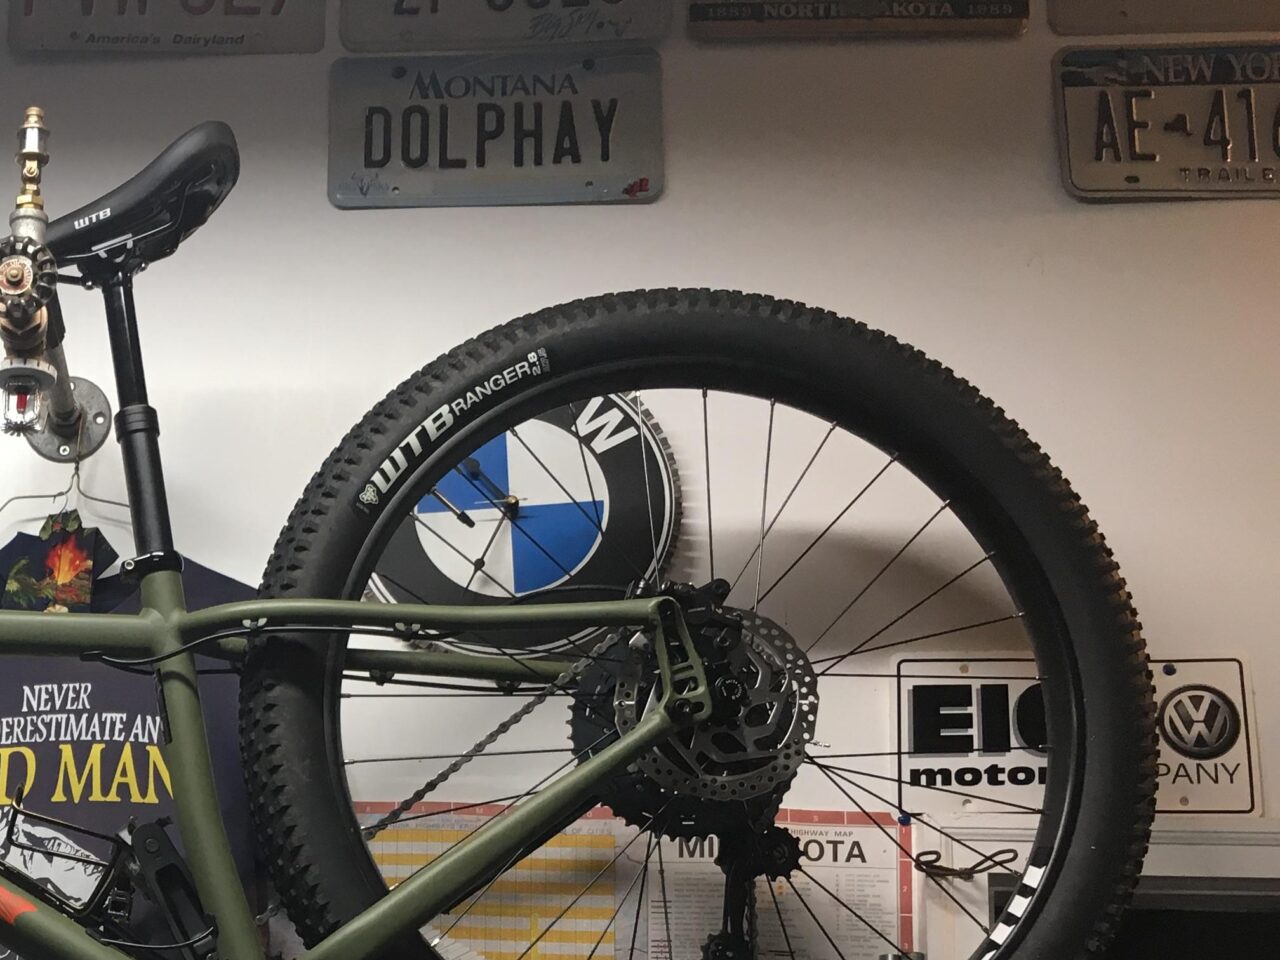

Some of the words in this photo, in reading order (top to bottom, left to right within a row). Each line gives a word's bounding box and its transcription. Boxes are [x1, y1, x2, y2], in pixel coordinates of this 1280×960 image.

[85, 32, 161, 46] America's
[172, 31, 246, 48] Dairyland
[1142, 53, 1217, 84] NEW
[408, 69, 580, 100] MONTANA
[362, 98, 620, 171] DOLPHAY
[1202, 87, 1280, 163] 41
[1178, 167, 1280, 183] TRAILE
[73, 207, 112, 231] WTB
[452, 361, 531, 417] RANGER
[527, 351, 541, 377] 2.8
[20, 682, 92, 714] NEVER
[51, 742, 174, 805] MAN
[790, 828, 829, 838] HIGHWAY
[835, 830, 854, 838] MAP
